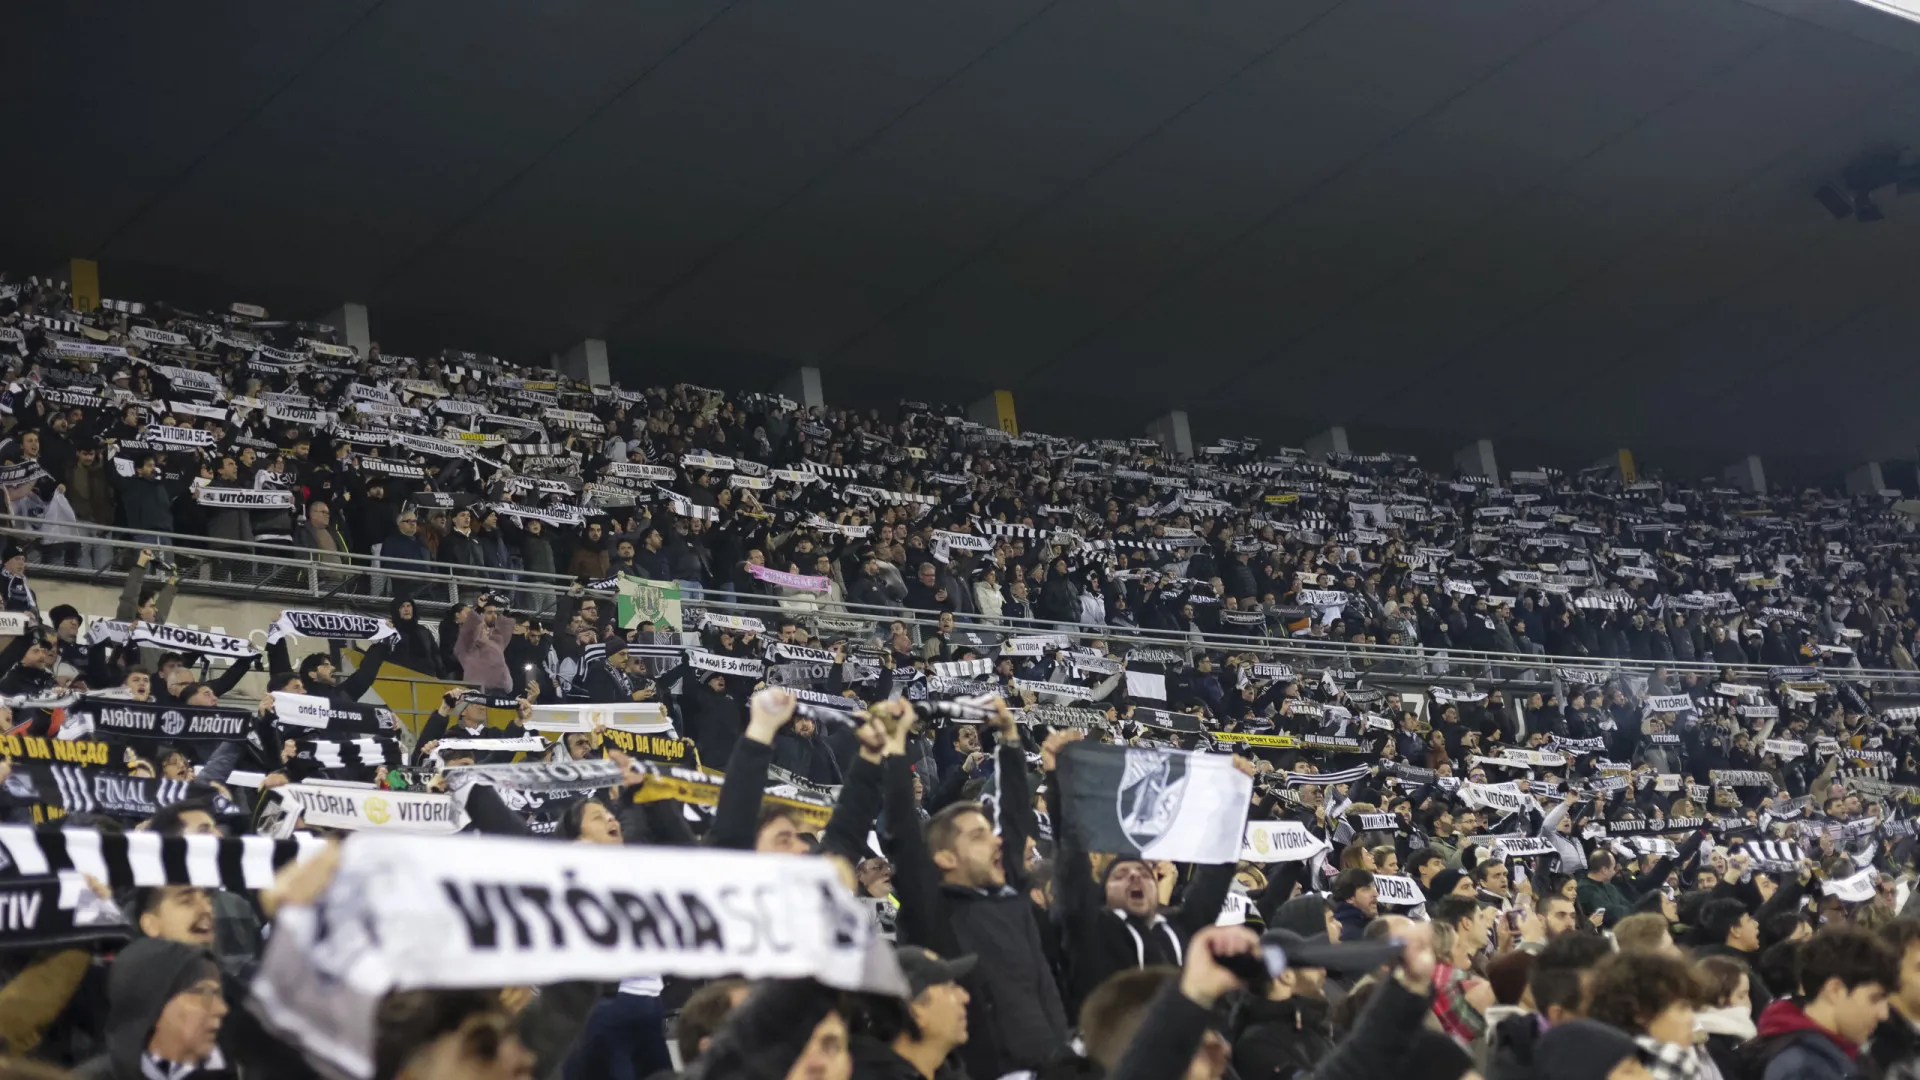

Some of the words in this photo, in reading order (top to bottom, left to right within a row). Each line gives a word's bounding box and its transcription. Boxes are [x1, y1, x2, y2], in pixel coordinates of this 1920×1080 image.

[403, 437, 460, 453] CONQUISTADORES
[287, 612, 378, 632] VENCEDORES
[299, 706, 317, 715] onde
[319, 707, 338, 719] fores
[339, 711, 348, 719] eu
[348, 712, 362, 721] vou
[25, 736, 51, 758] DA
[636, 735, 649, 748] DA
[94, 776, 147, 804] FINAL
[398, 801, 452, 821] VITÓRI
[446, 870, 722, 948] VITÓRIA
